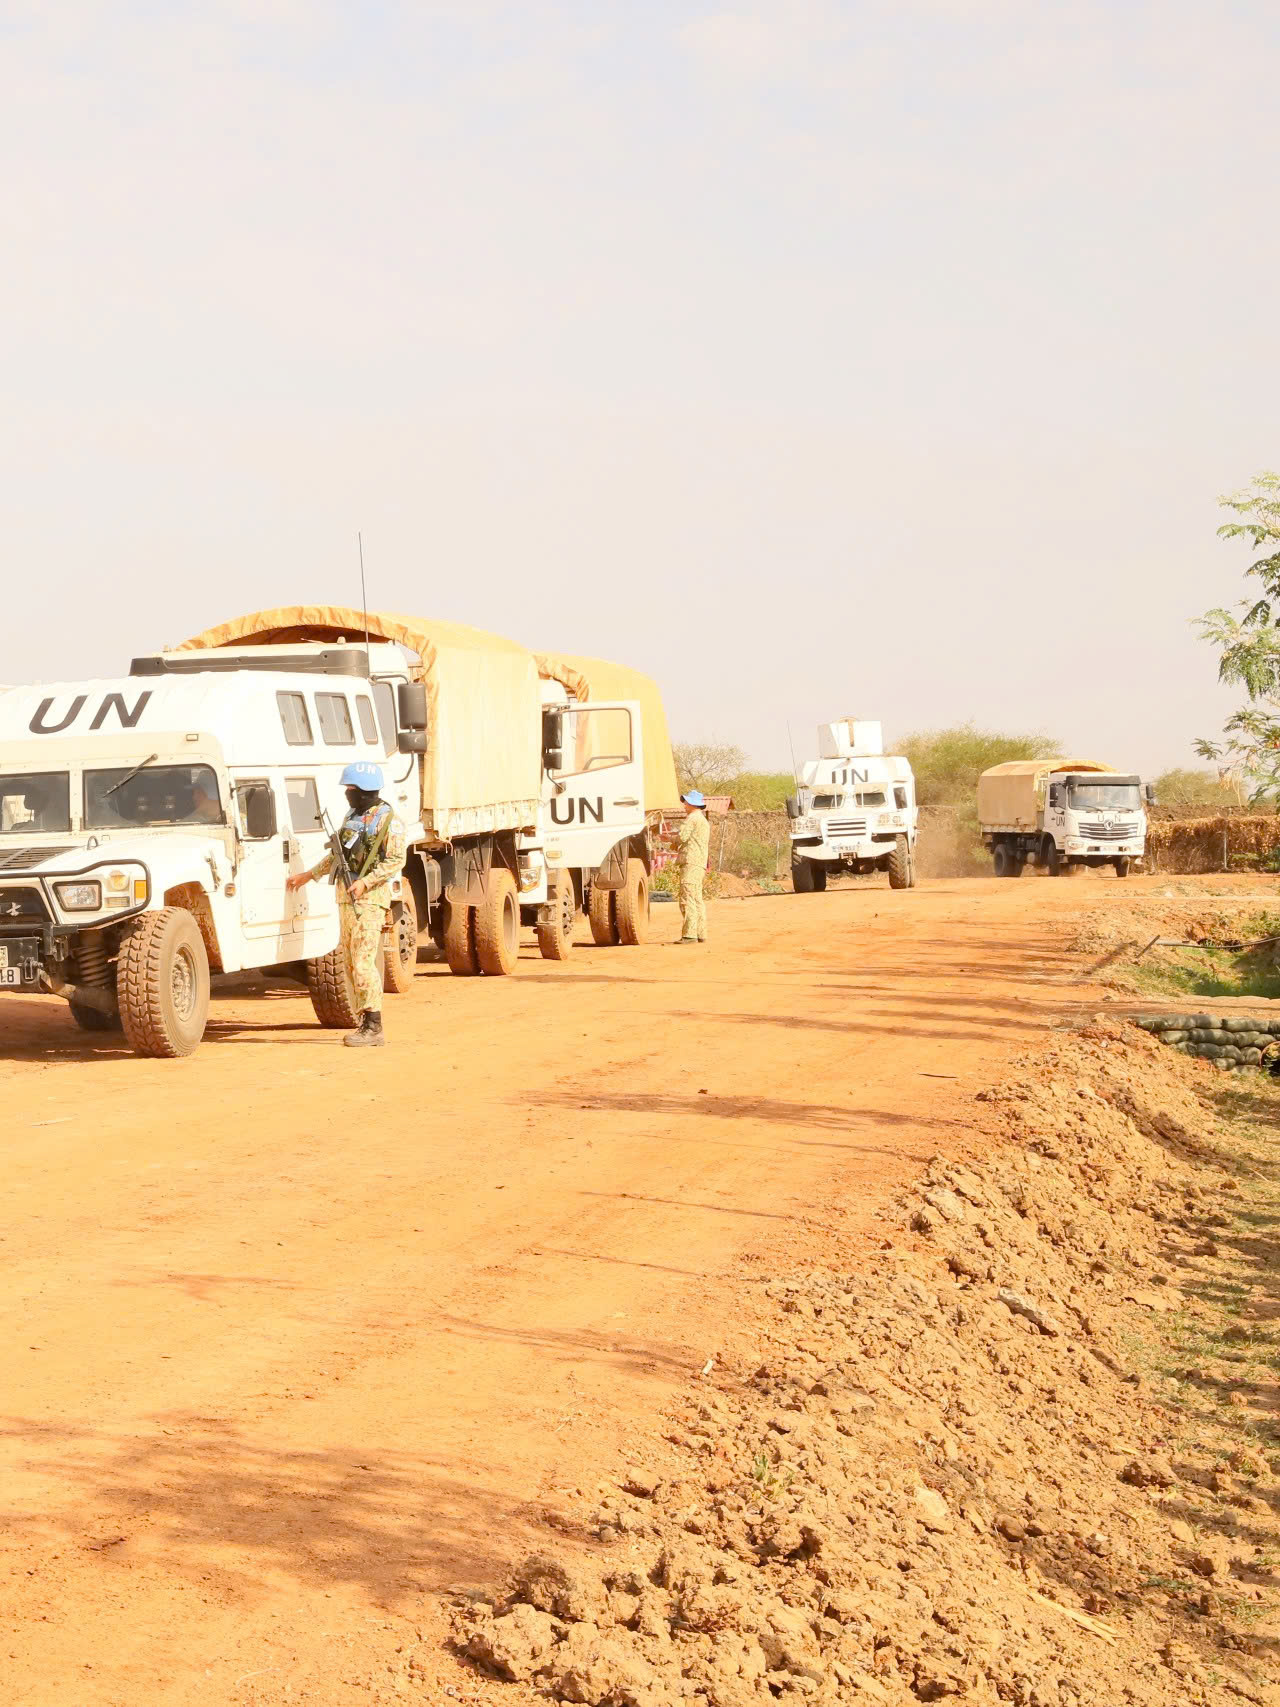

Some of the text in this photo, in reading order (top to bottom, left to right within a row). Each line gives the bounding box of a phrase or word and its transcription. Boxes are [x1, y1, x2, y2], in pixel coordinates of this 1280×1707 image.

[28, 691, 153, 734] UN
[832, 769, 868, 785] UN
[550, 796, 604, 825] UN
